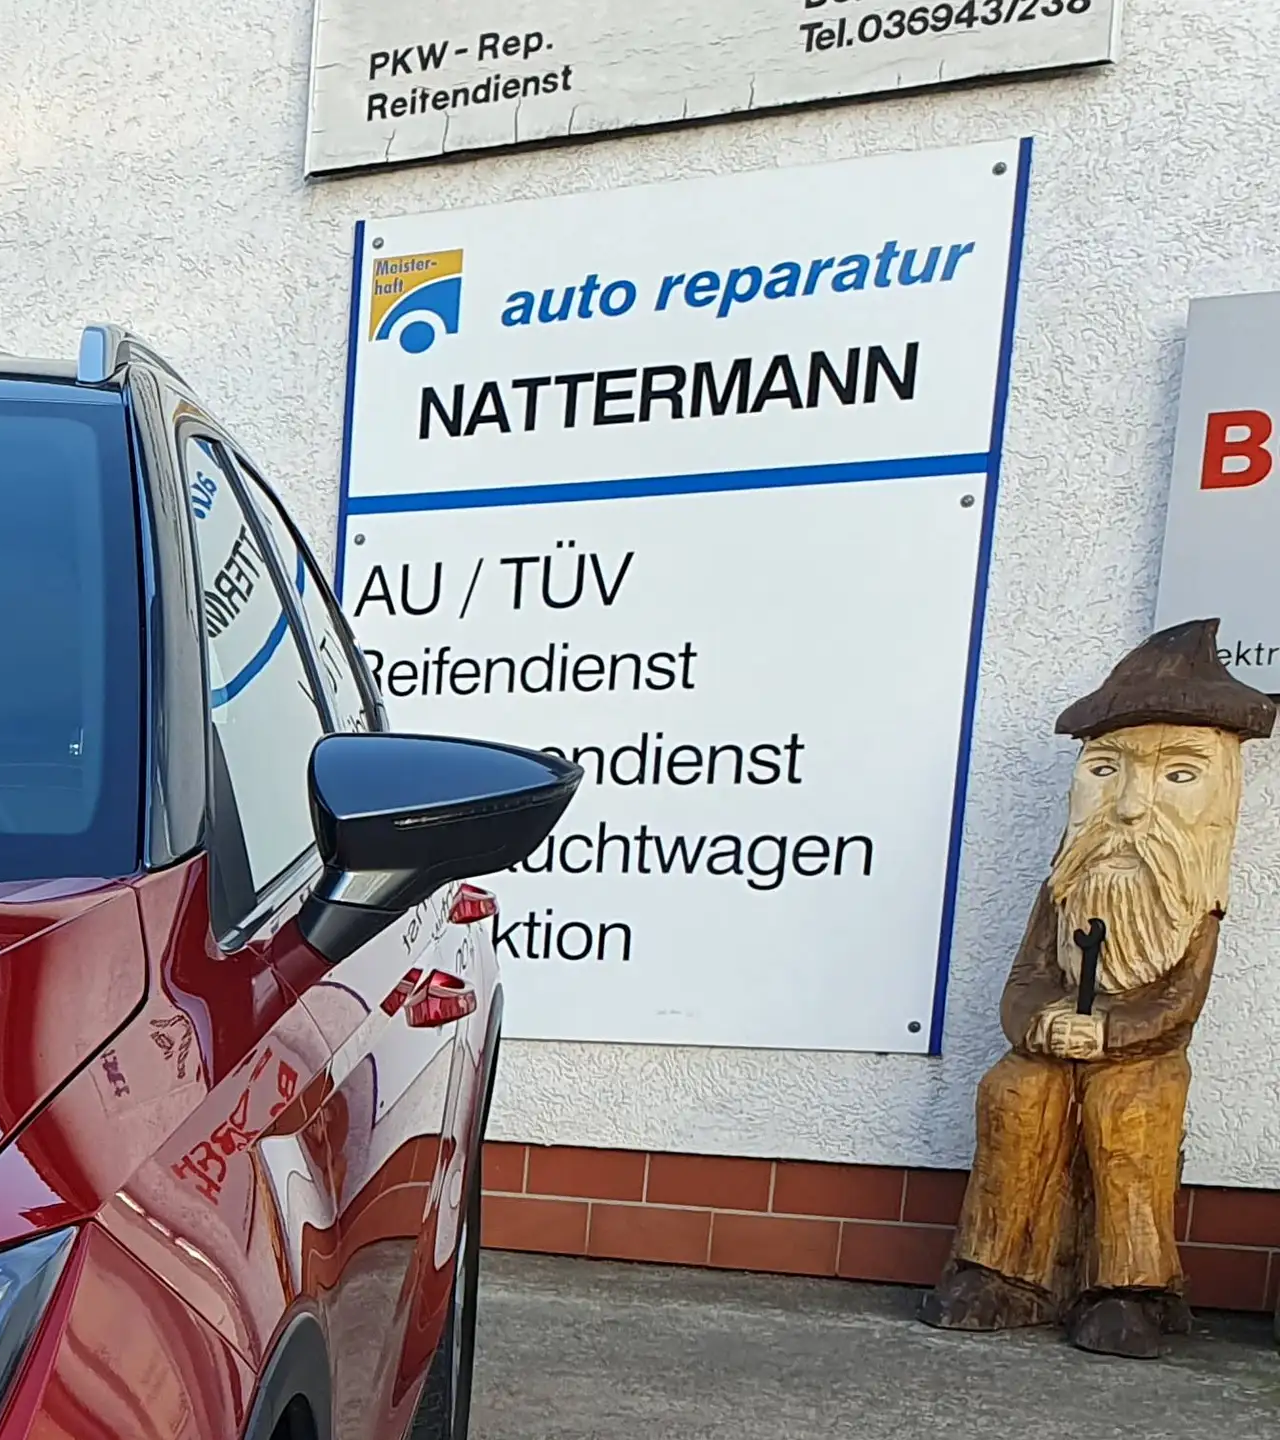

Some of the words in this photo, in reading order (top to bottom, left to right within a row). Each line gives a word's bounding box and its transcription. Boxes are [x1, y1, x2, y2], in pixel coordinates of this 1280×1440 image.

[369, 40, 449, 80] PKW
[478, 32, 553, 61] Rep.
[374, 277, 404, 295] haft
[501, 274, 637, 327] auto
[654, 240, 976, 319] reparatur
[418, 341, 920, 440] NATTERMANN
[353, 562, 443, 617] AU
[459, 558, 484, 619] /
[500, 540, 635, 609] TÜV
[506, 821, 874, 890] uchtwagen
